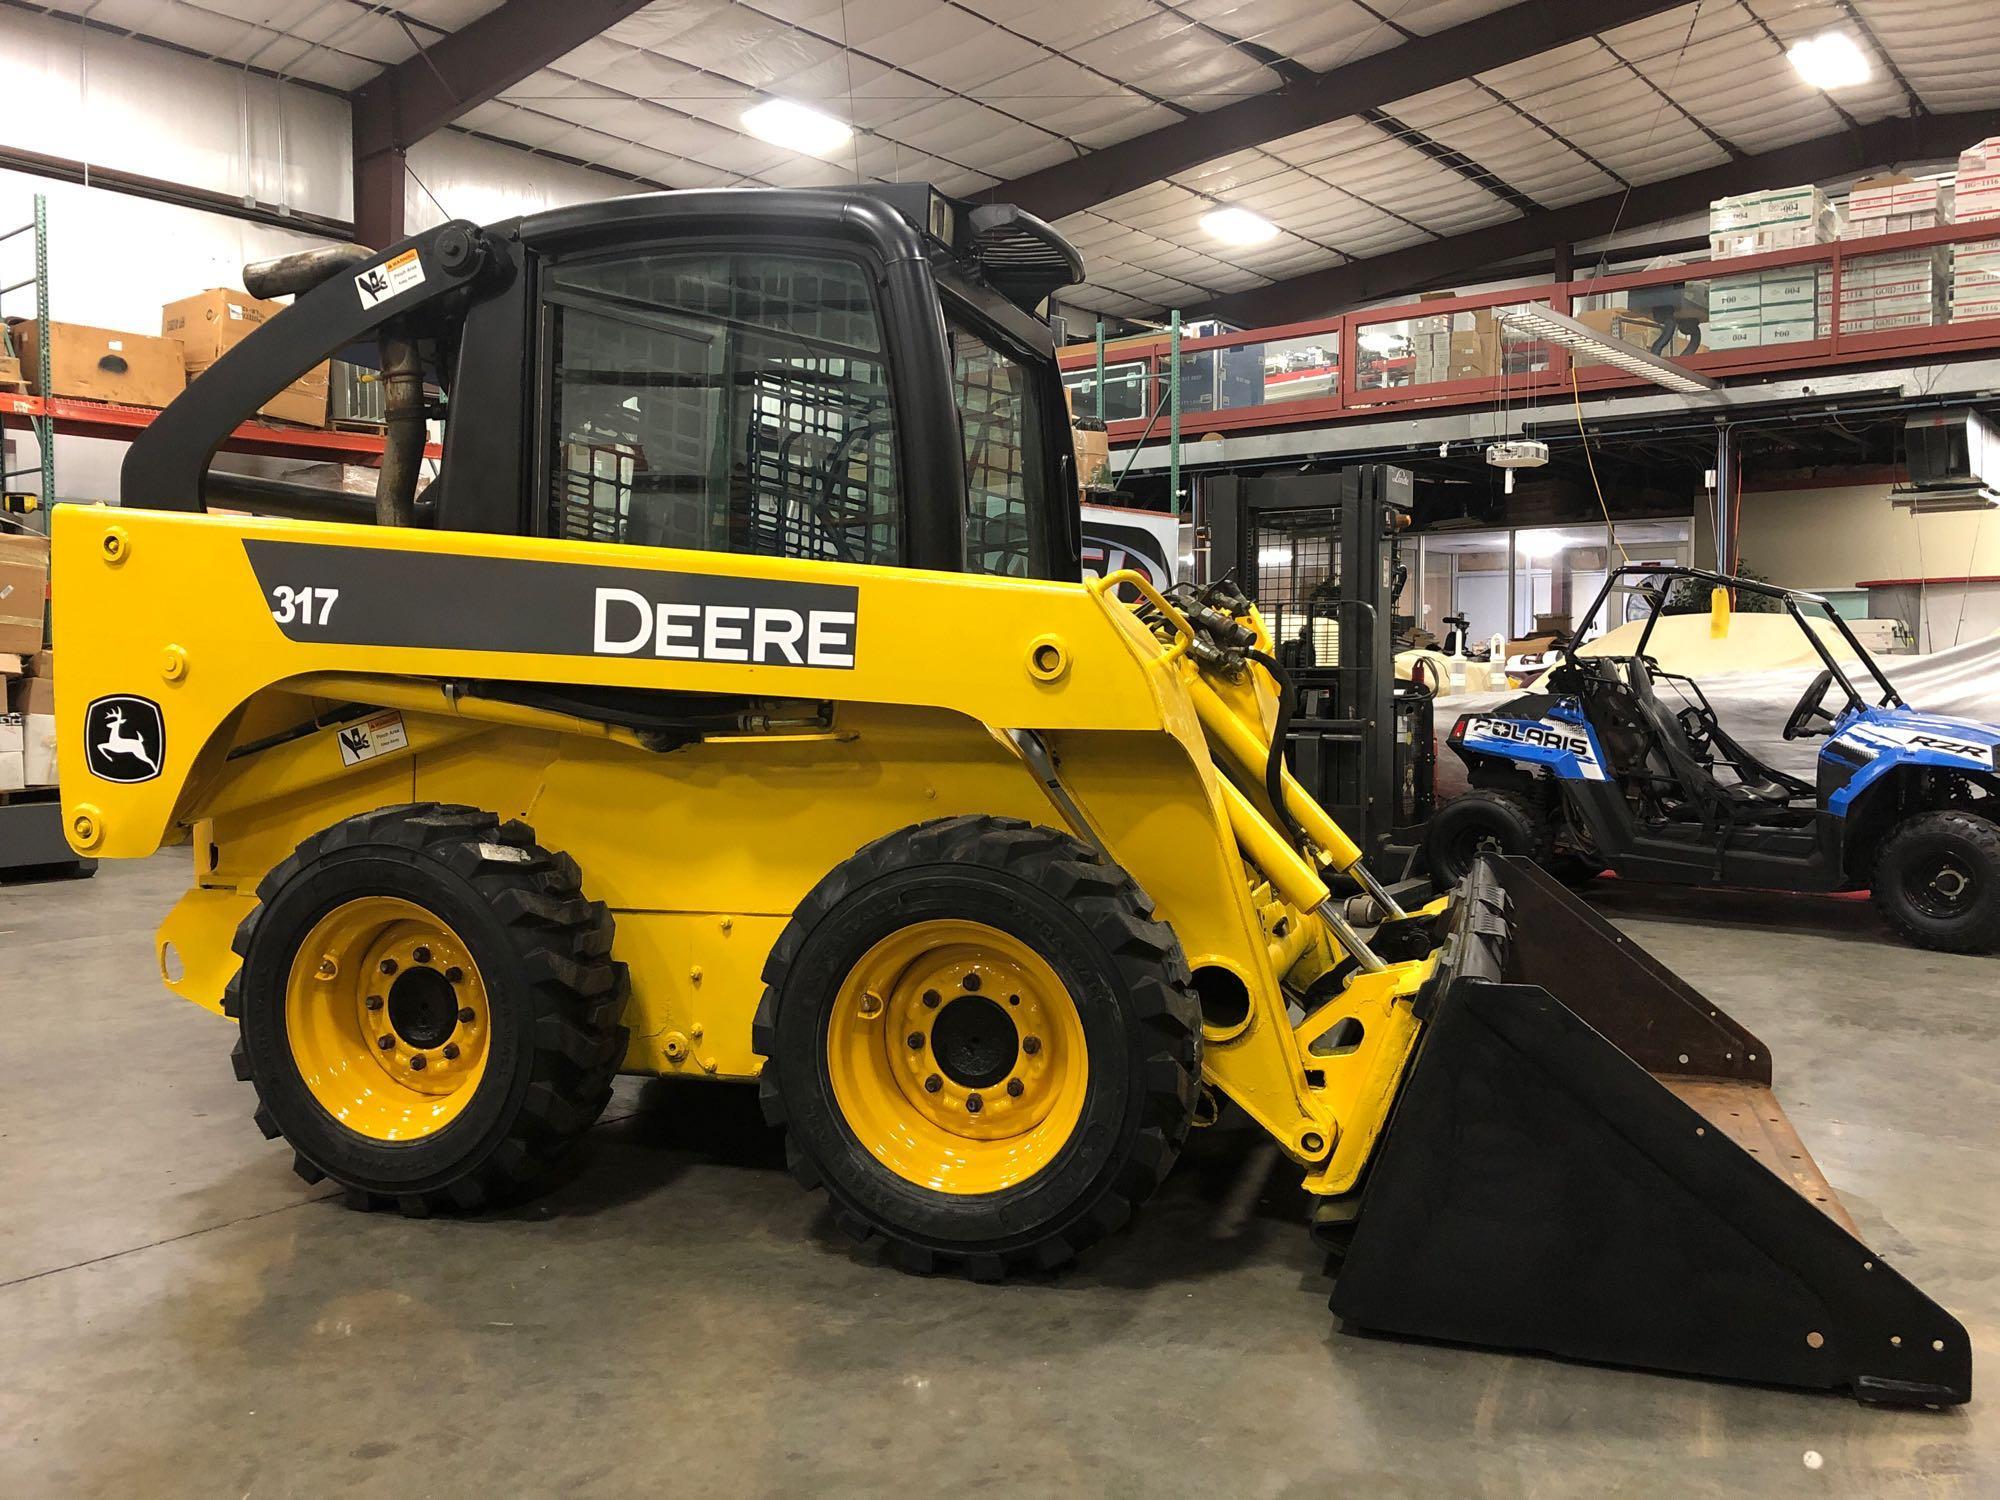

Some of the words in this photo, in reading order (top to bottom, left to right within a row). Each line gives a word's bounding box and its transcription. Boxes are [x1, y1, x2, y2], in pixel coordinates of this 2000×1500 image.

[271, 584, 339, 626] 317
[593, 587, 856, 668] DEERE
[1473, 718, 1588, 756] POLARIS
[1906, 735, 1989, 758] RZR
